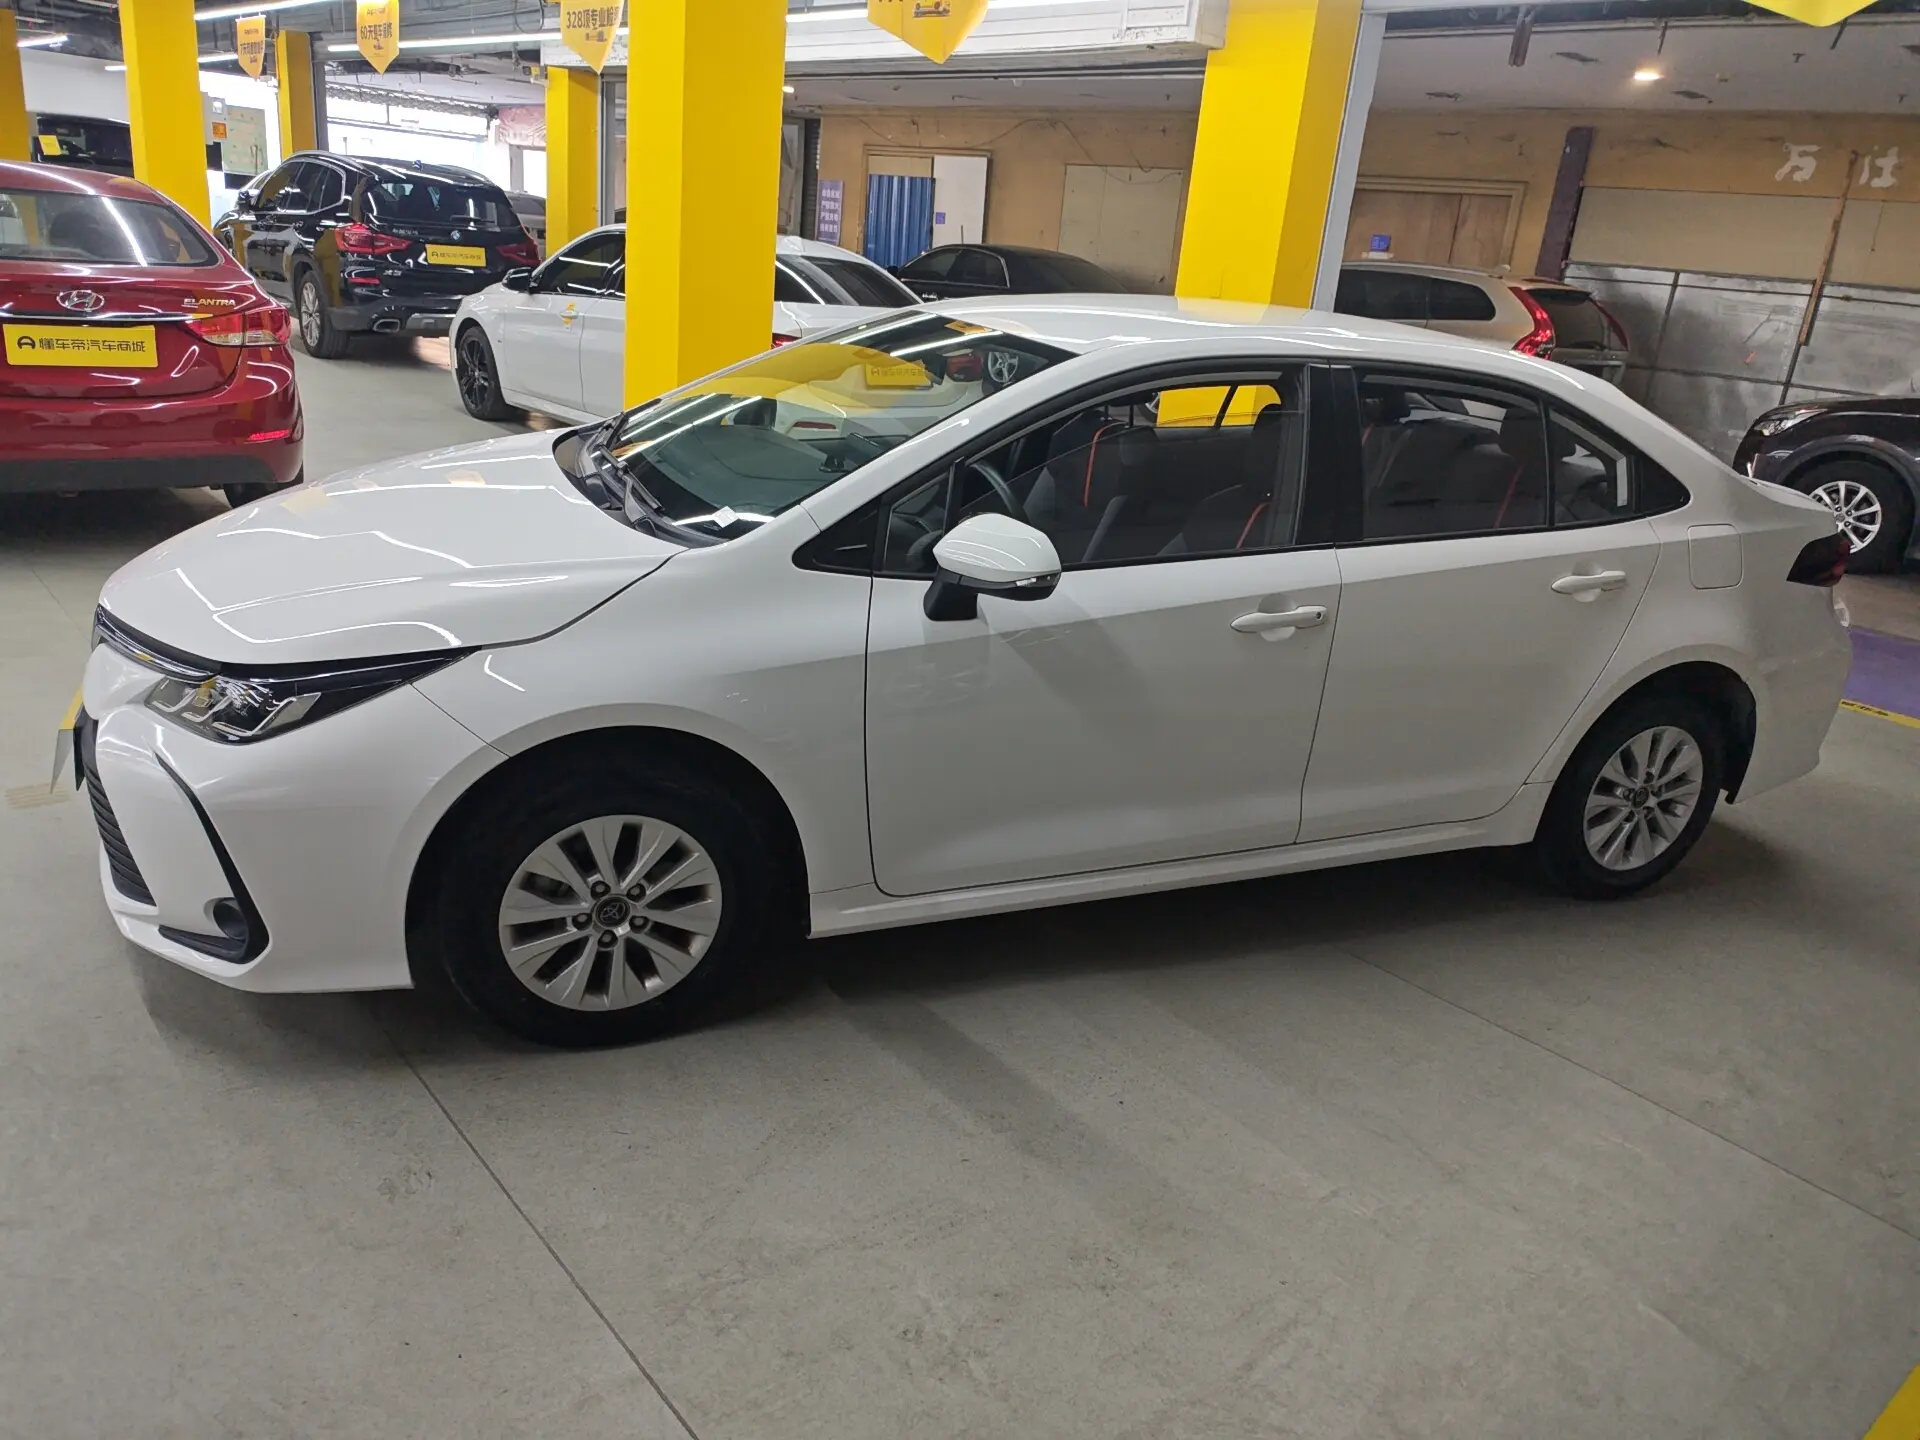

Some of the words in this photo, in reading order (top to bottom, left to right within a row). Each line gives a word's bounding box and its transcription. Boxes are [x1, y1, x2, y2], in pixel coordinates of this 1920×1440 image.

[183, 298, 236, 306] ELANTRA
[39, 338, 146, 352] 懂车帝汽车商城
